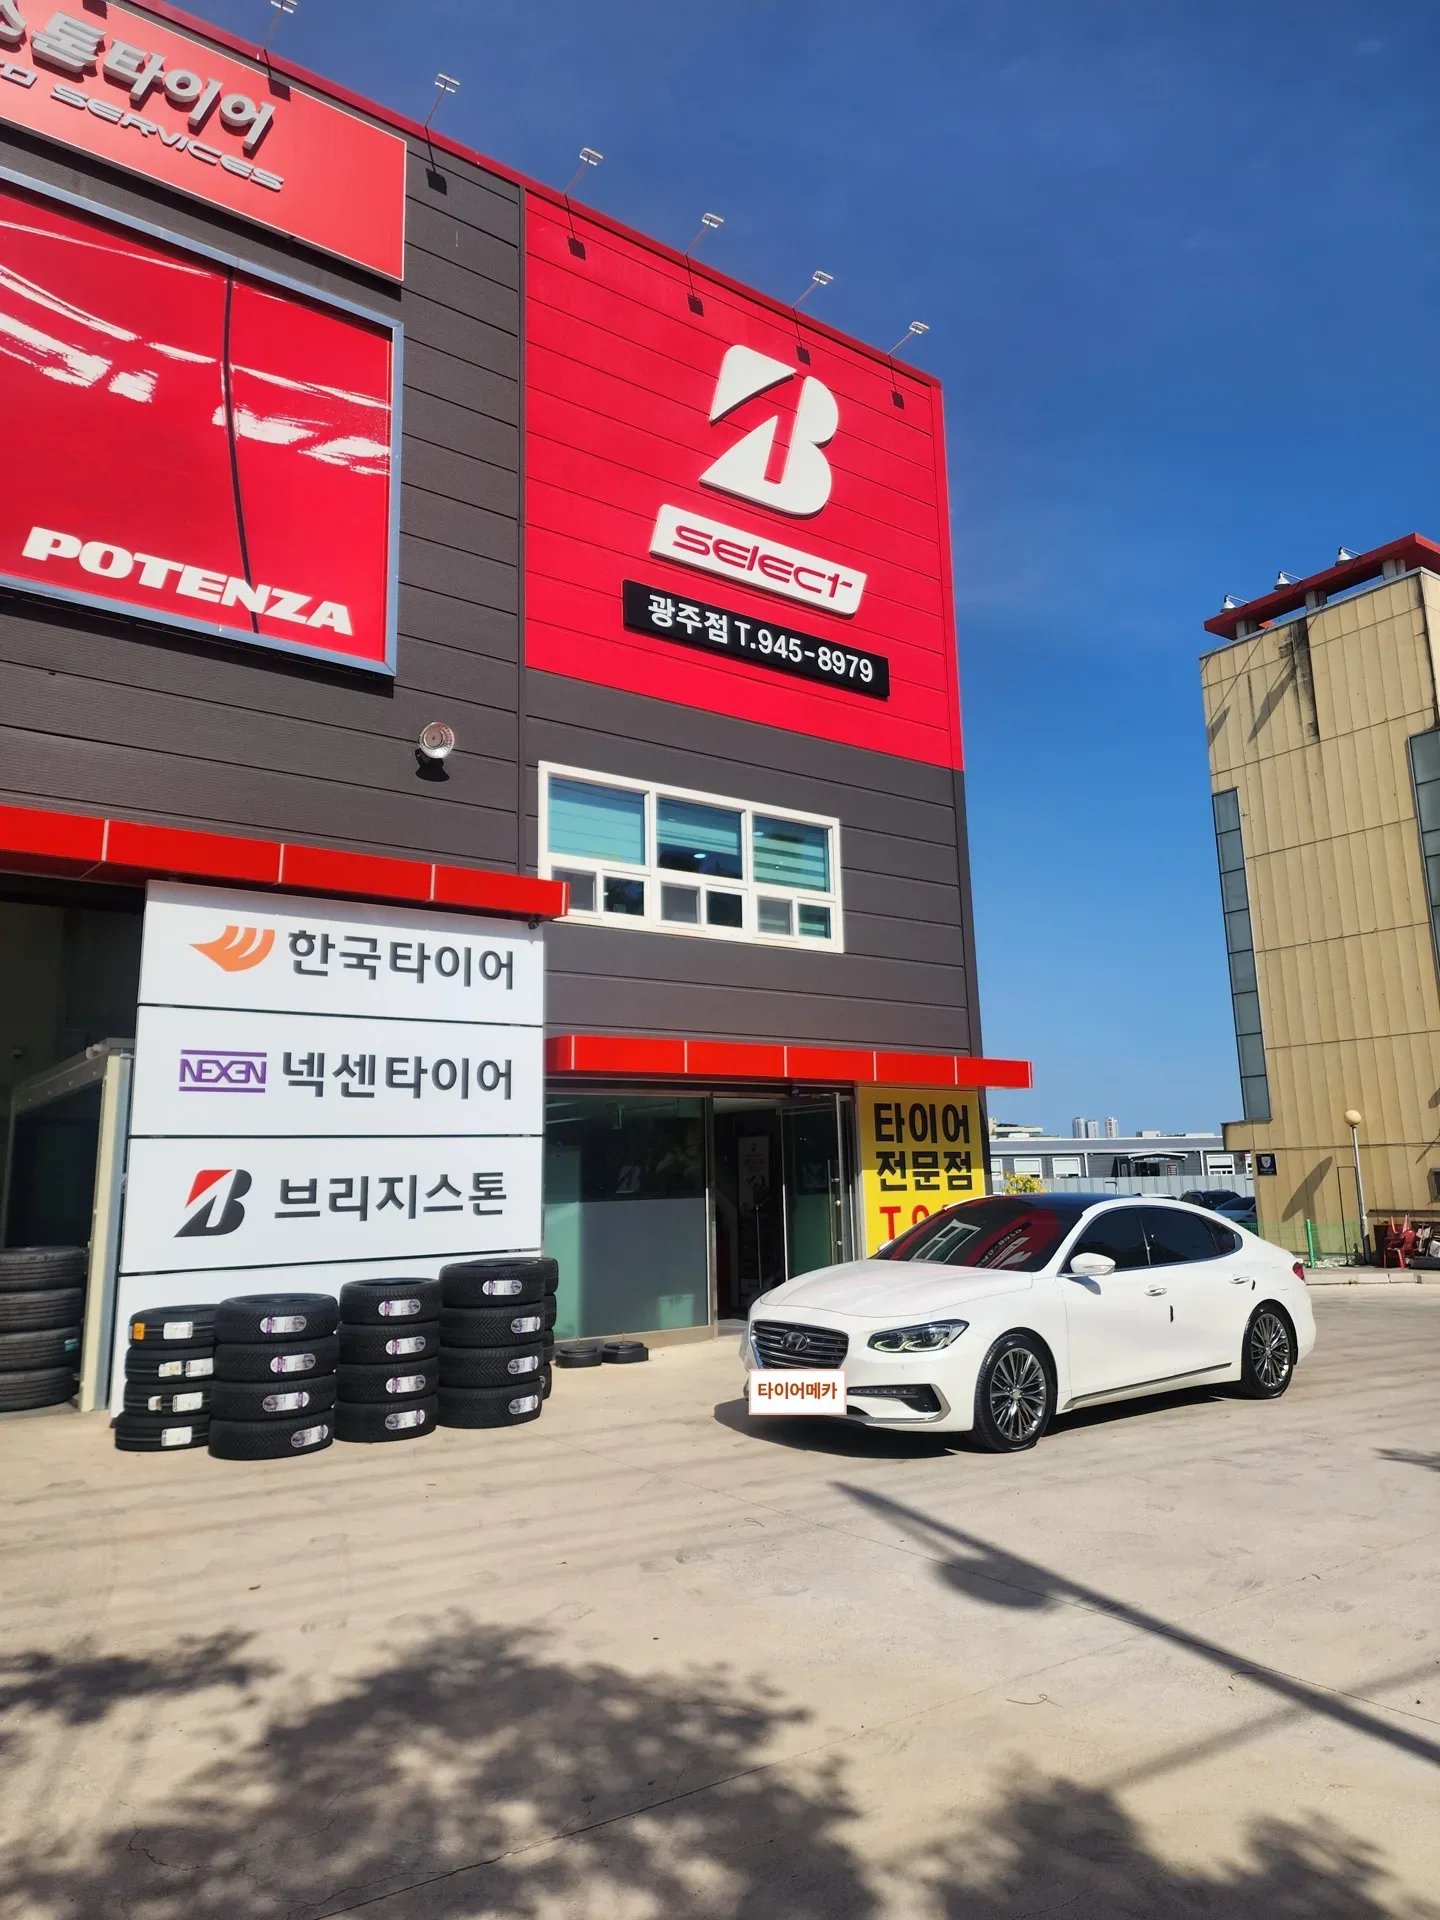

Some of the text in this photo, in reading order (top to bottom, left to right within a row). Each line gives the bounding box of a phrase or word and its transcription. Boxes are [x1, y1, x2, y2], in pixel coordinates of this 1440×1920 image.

[50, 83, 284, 192] SERVICES
[22, 526, 353, 636] POTENZA
[648, 593, 874, 683] 광주점 T.945-8979
[288, 929, 514, 990] 한국타이어
[179, 1051, 513, 1100] NEXEN 넥센타이어
[873, 1102, 970, 1144] 타이어
[274, 1171, 508, 1223] 브리지스톤
[875, 1150, 973, 1191] 전문점
